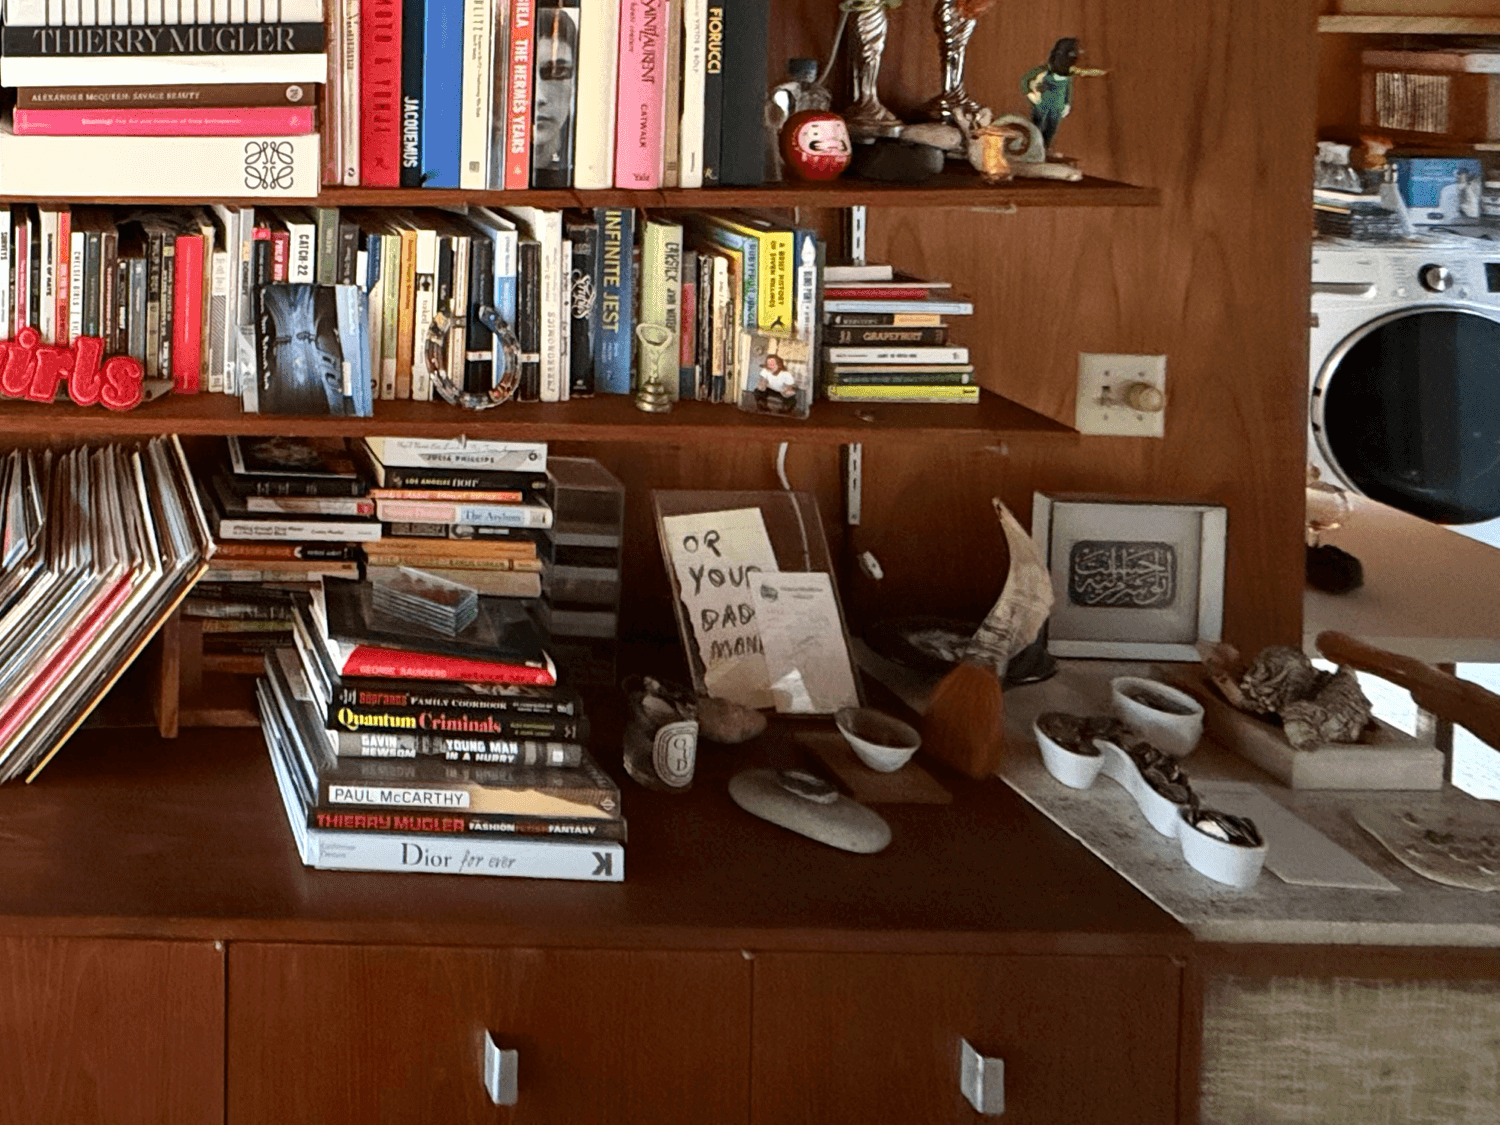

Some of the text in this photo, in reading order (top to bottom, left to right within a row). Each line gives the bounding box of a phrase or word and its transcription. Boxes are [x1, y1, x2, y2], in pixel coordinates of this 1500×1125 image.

[472, 0, 485, 32] BLITZ
[32, 26, 296, 54] THIERRY MUGLER
[514, 39, 529, 63] THE
[707, 7, 723, 74] FIORUCCI
[31, 91, 201, 102] ALEXANDER SAVAGE BEAUTY
[403, 96, 420, 168] JACQUEMUS
[510, 116, 526, 155] YEARS
[639, 103, 649, 148] CATWALK
[0, 231, 8, 261] SURVEYS
[297, 234, 310, 277] CATCH-22
[602, 210, 622, 334] INFINITE JEST
[664, 241, 679, 283] CARSICK
[72, 251, 81, 306] CHELSEA GIRLS
[746, 294, 756, 329] JUNGLE
[862, 331, 922, 341] GRAPEFRUIT
[455, 455, 495, 464] PHILLIPS
[683, 530, 721, 557] OR
[701, 603, 756, 632] DAD
[411, 696, 448, 707] FAMILY
[451, 698, 507, 710] COOKBOOK
[338, 708, 416, 731] Quantum
[419, 712, 501, 734] Criminals
[362, 736, 397, 748] GAVIN
[362, 748, 416, 758] NEWSOM
[445, 739, 518, 755] YOUNG MAN
[446, 752, 460, 762] IN
[475, 753, 515, 764] HURRY
[335, 788, 464, 806] PAUL McCARTHY
[316, 814, 596, 835] THIERRY MUGLER FASHION FANTASY
[400, 842, 516, 872] Dior for ever
